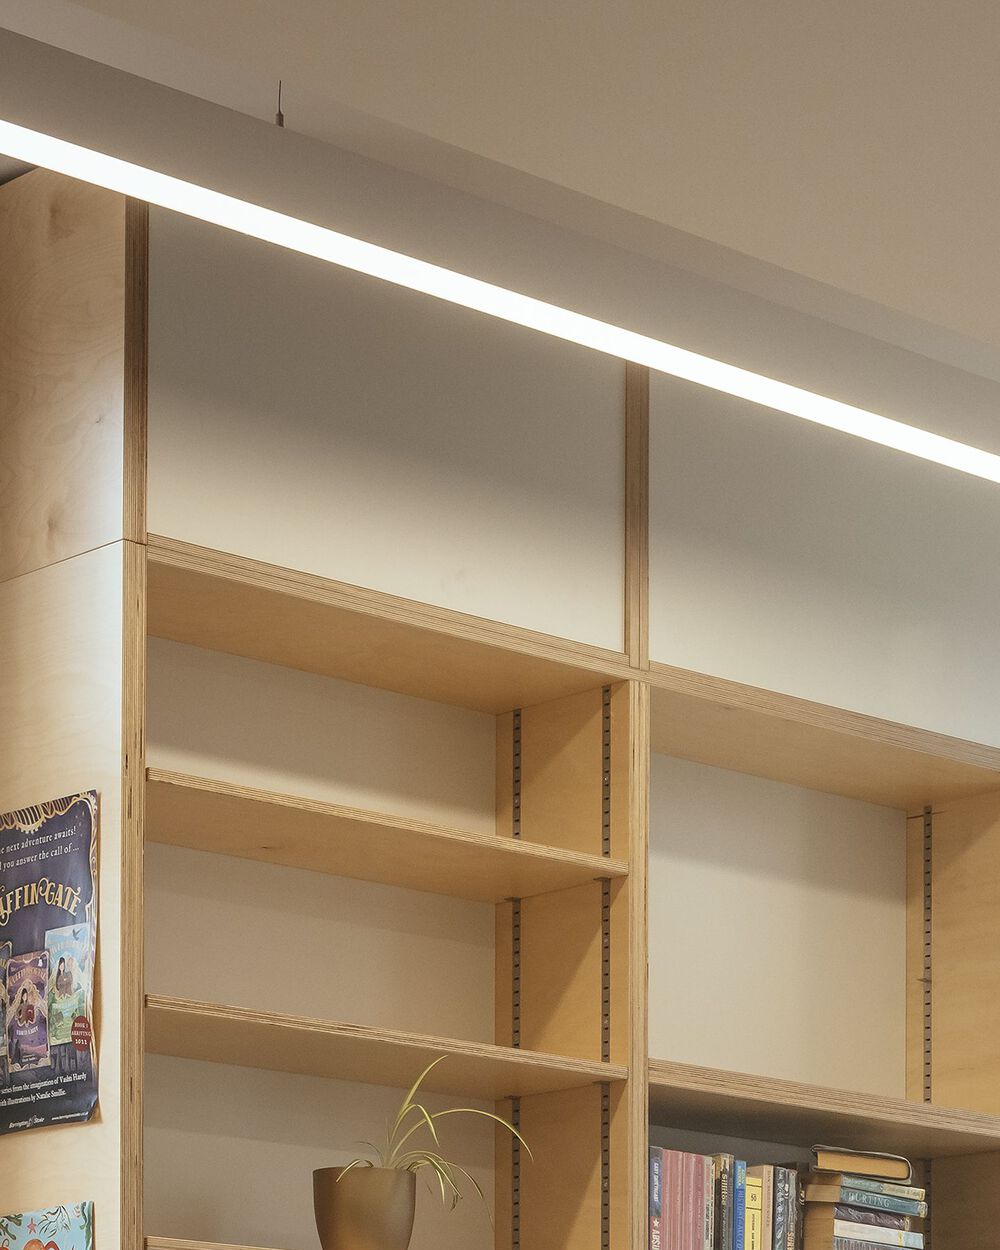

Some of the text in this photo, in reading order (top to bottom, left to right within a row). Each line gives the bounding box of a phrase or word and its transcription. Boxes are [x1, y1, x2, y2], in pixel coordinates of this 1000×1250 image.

[21, 834, 53, 849] adventure
[16, 854, 38, 866] answer
[38, 849, 49, 860] the
[50, 845, 63, 857] call
[39, 877, 82, 916] GATE
